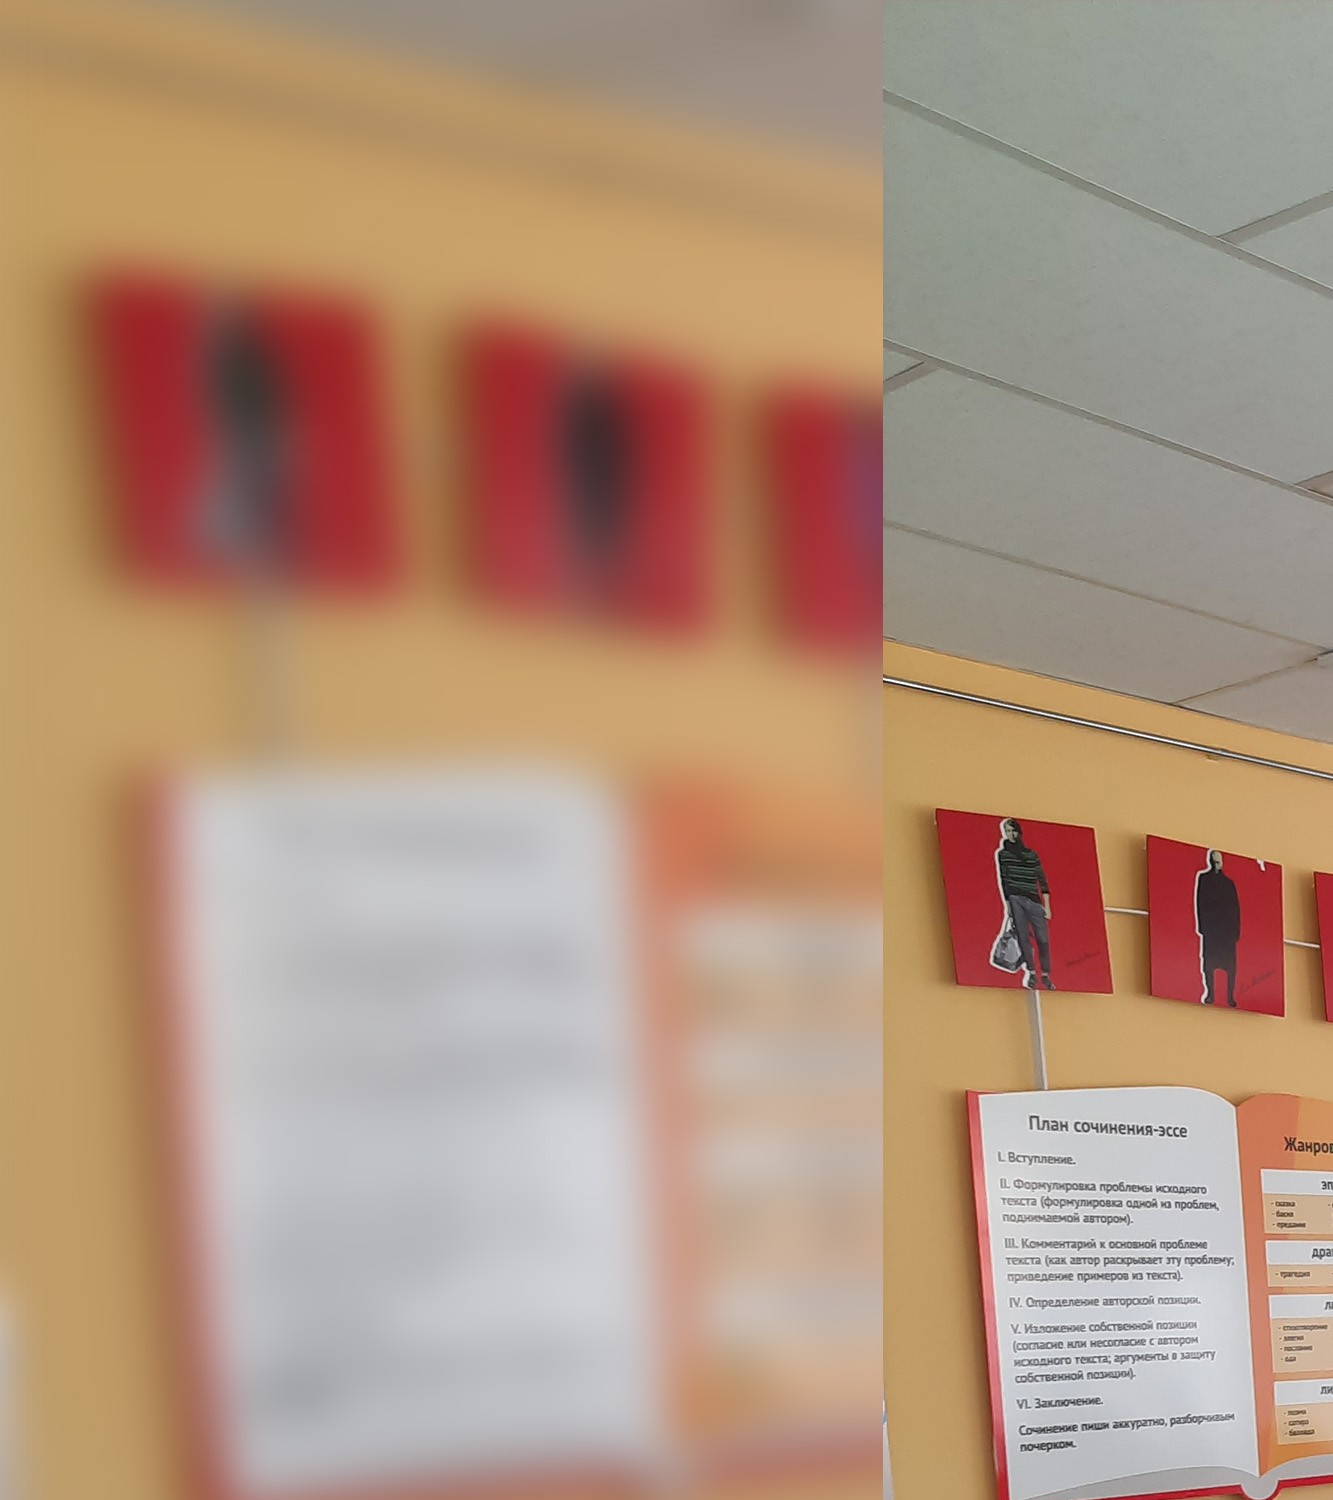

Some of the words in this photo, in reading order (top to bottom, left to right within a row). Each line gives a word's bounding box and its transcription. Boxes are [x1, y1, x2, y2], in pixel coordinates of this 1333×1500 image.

[1029, 1115, 1068, 1131] План
[1074, 1120, 1187, 1138] сочинения-эссе
[1008, 1152, 1076, 1166] Вступление.
[1014, 1178, 1096, 1193] Формулировка
[1100, 1181, 1153, 1194] проблемы
[1156, 1184, 1207, 1195] исходного
[1002, 1197, 1037, 1206] текста
[1041, 1196, 1123, 1210] (формулировка
[1126, 1198, 1157, 1209] одной
[1161, 1201, 1171, 1209] из
[1175, 1200, 1220, 1212] проблем,
[1003, 1212, 1080, 1224] поднимаемой
[1083, 1214, 1133, 1226] автором).
[1021, 1238, 1096, 1251] Комментарий
[1109, 1239, 1156, 1249] основной
[1160, 1239, 1207, 1250] проблеме
[1006, 1256, 1041, 1265] текста
[1044, 1255, 1067, 1268] (как
[1070, 1256, 1100, 1267] автор
[1104, 1256, 1162, 1267] раскрывает
[1166, 1257, 1181, 1267] эту
[1007, 1272, 1073, 1283] приведение
[1077, 1272, 1129, 1283] примеров
[1132, 1272, 1143, 1280] из
[1146, 1269, 1183, 1282] текста).
[1026, 1297, 1099, 1308] Определение
[1102, 1296, 1154, 1308] авторской
[1025, 1323, 1086, 1334] Изложение
[1089, 1321, 1153, 1332] собственной
[1013, 1340, 1063, 1353] (согласие
[1067, 1340, 1087, 1349] или
[1090, 1339, 1146, 1348] несогласие
[1149, 1337, 1154, 1345] с
[1158, 1336, 1198, 1346] автором
[1014, 1356, 1072, 1367] исходного
[1114, 1352, 1169, 1364] аргументы
[1015, 1371, 1084, 1384] собственной
[1035, 1396, 1103, 1409] Заключение.
[1019, 1423, 1078, 1436] Сочинение
[1081, 1421, 1110, 1431] пиши
[1112, 1418, 1168, 1431] аккуратно,
[1020, 1440, 1076, 1452] почерком.
